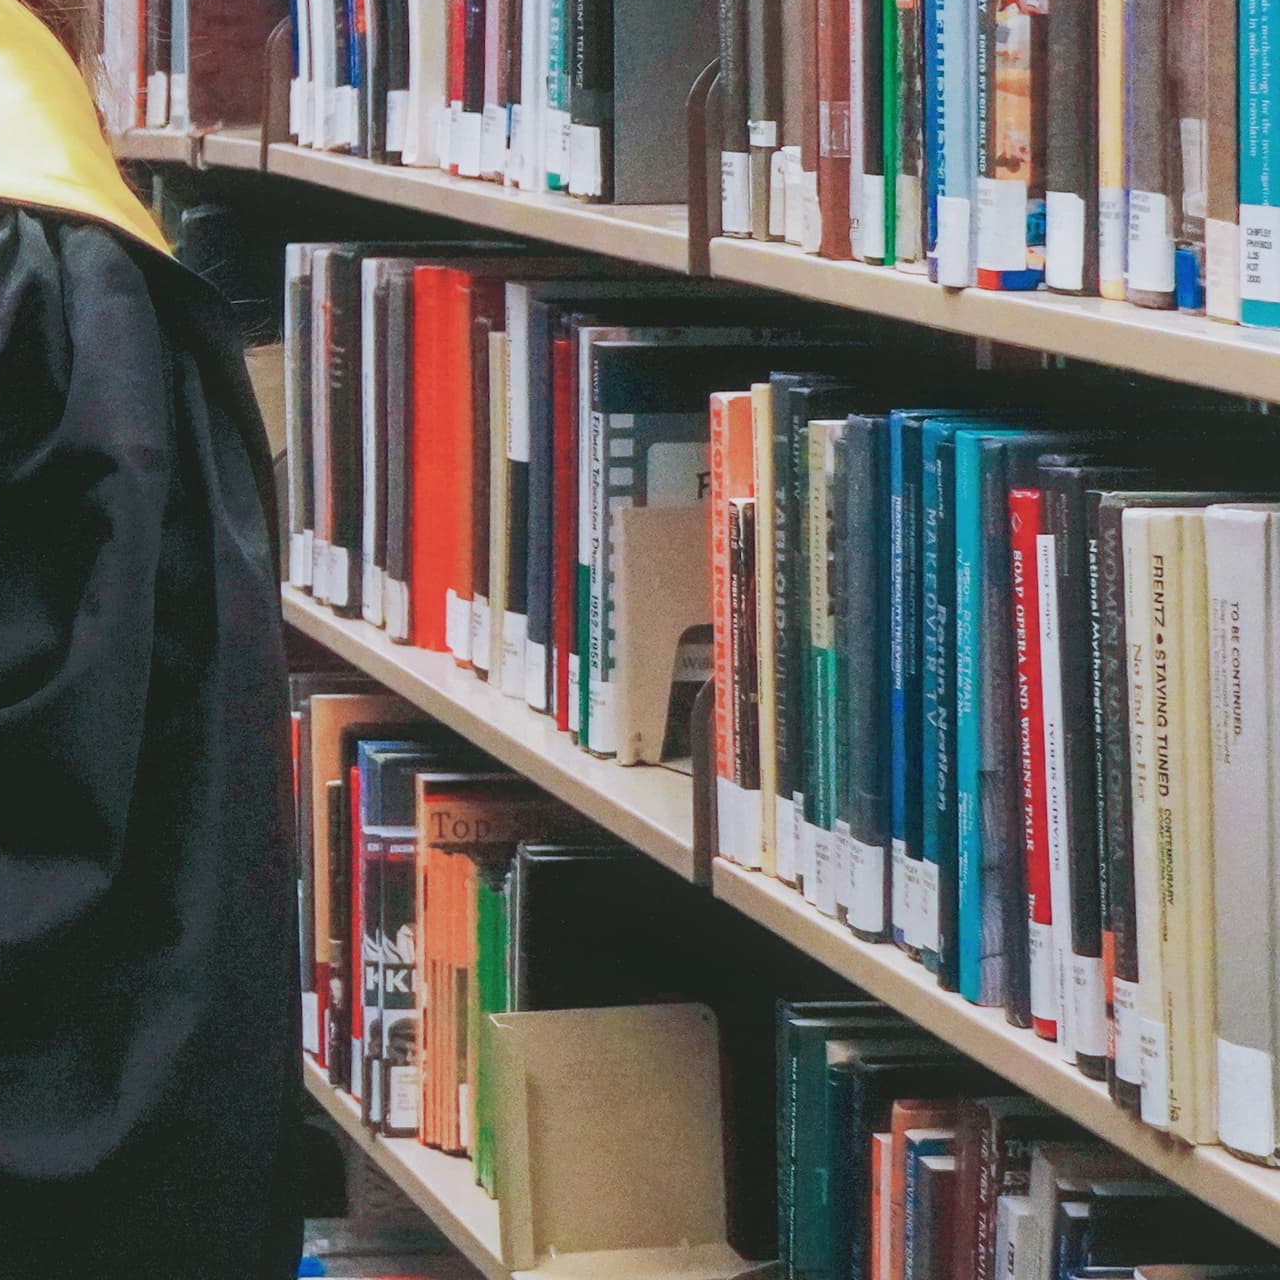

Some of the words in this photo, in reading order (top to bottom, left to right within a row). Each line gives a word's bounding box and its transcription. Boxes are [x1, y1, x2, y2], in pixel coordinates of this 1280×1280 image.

[1248, 18, 1259, 30] in
[1248, 32, 1260, 95] audiovisual
[1258, 25, 1272, 95] methodology
[1248, 98, 1260, 157] translation
[1260, 99, 1272, 115] for
[1261, 118, 1272, 134] the
[592, 414, 601, 462] Filmed
[792, 414, 801, 476] REALITY
[591, 468, 601, 532] Television
[711, 408, 727, 557] PEOPLE'S
[793, 480, 801, 500] TV
[894, 496, 902, 555] REACTING
[591, 537, 601, 584] Drama
[812, 486, 823, 641] TELEMODERNITIES
[894, 557, 902, 572] TO
[924, 507, 938, 672] MAKEOVER
[1012, 549, 1025, 598] SOAP
[1088, 538, 1101, 618] National
[1103, 527, 1120, 645] WOMEN
[731, 573, 739, 610] PUBLIC
[1152, 554, 1166, 628] FRENTZ
[1230, 600, 1240, 622] TO
[591, 594, 600, 669] 1952-1958
[893, 626, 902, 690] TELEVISION
[937, 603, 947, 695] Rerun
[1015, 604, 1027, 664] OPERA
[1132, 643, 1143, 675] No
[1231, 625, 1240, 642] BE
[715, 565, 730, 778] INSTRUMENT
[1018, 674, 1030, 709] AND
[1091, 620, 1103, 734] Mythologies
[1154, 648, 1167, 728] STAYING
[929, 692, 938, 727] TV
[1133, 684, 1145, 725] End
[936, 700, 948, 812] Nation
[1021, 716, 1032, 798] WOMEN'S
[1135, 734, 1144, 755] to
[1157, 734, 1170, 798] TUNED
[1136, 762, 1147, 803] Her
[430, 811, 491, 843] Top
[1024, 804, 1035, 852] TALK
[1163, 807, 1175, 906] CONTEMPORARY
[979, 1166, 989, 1203] NEW
